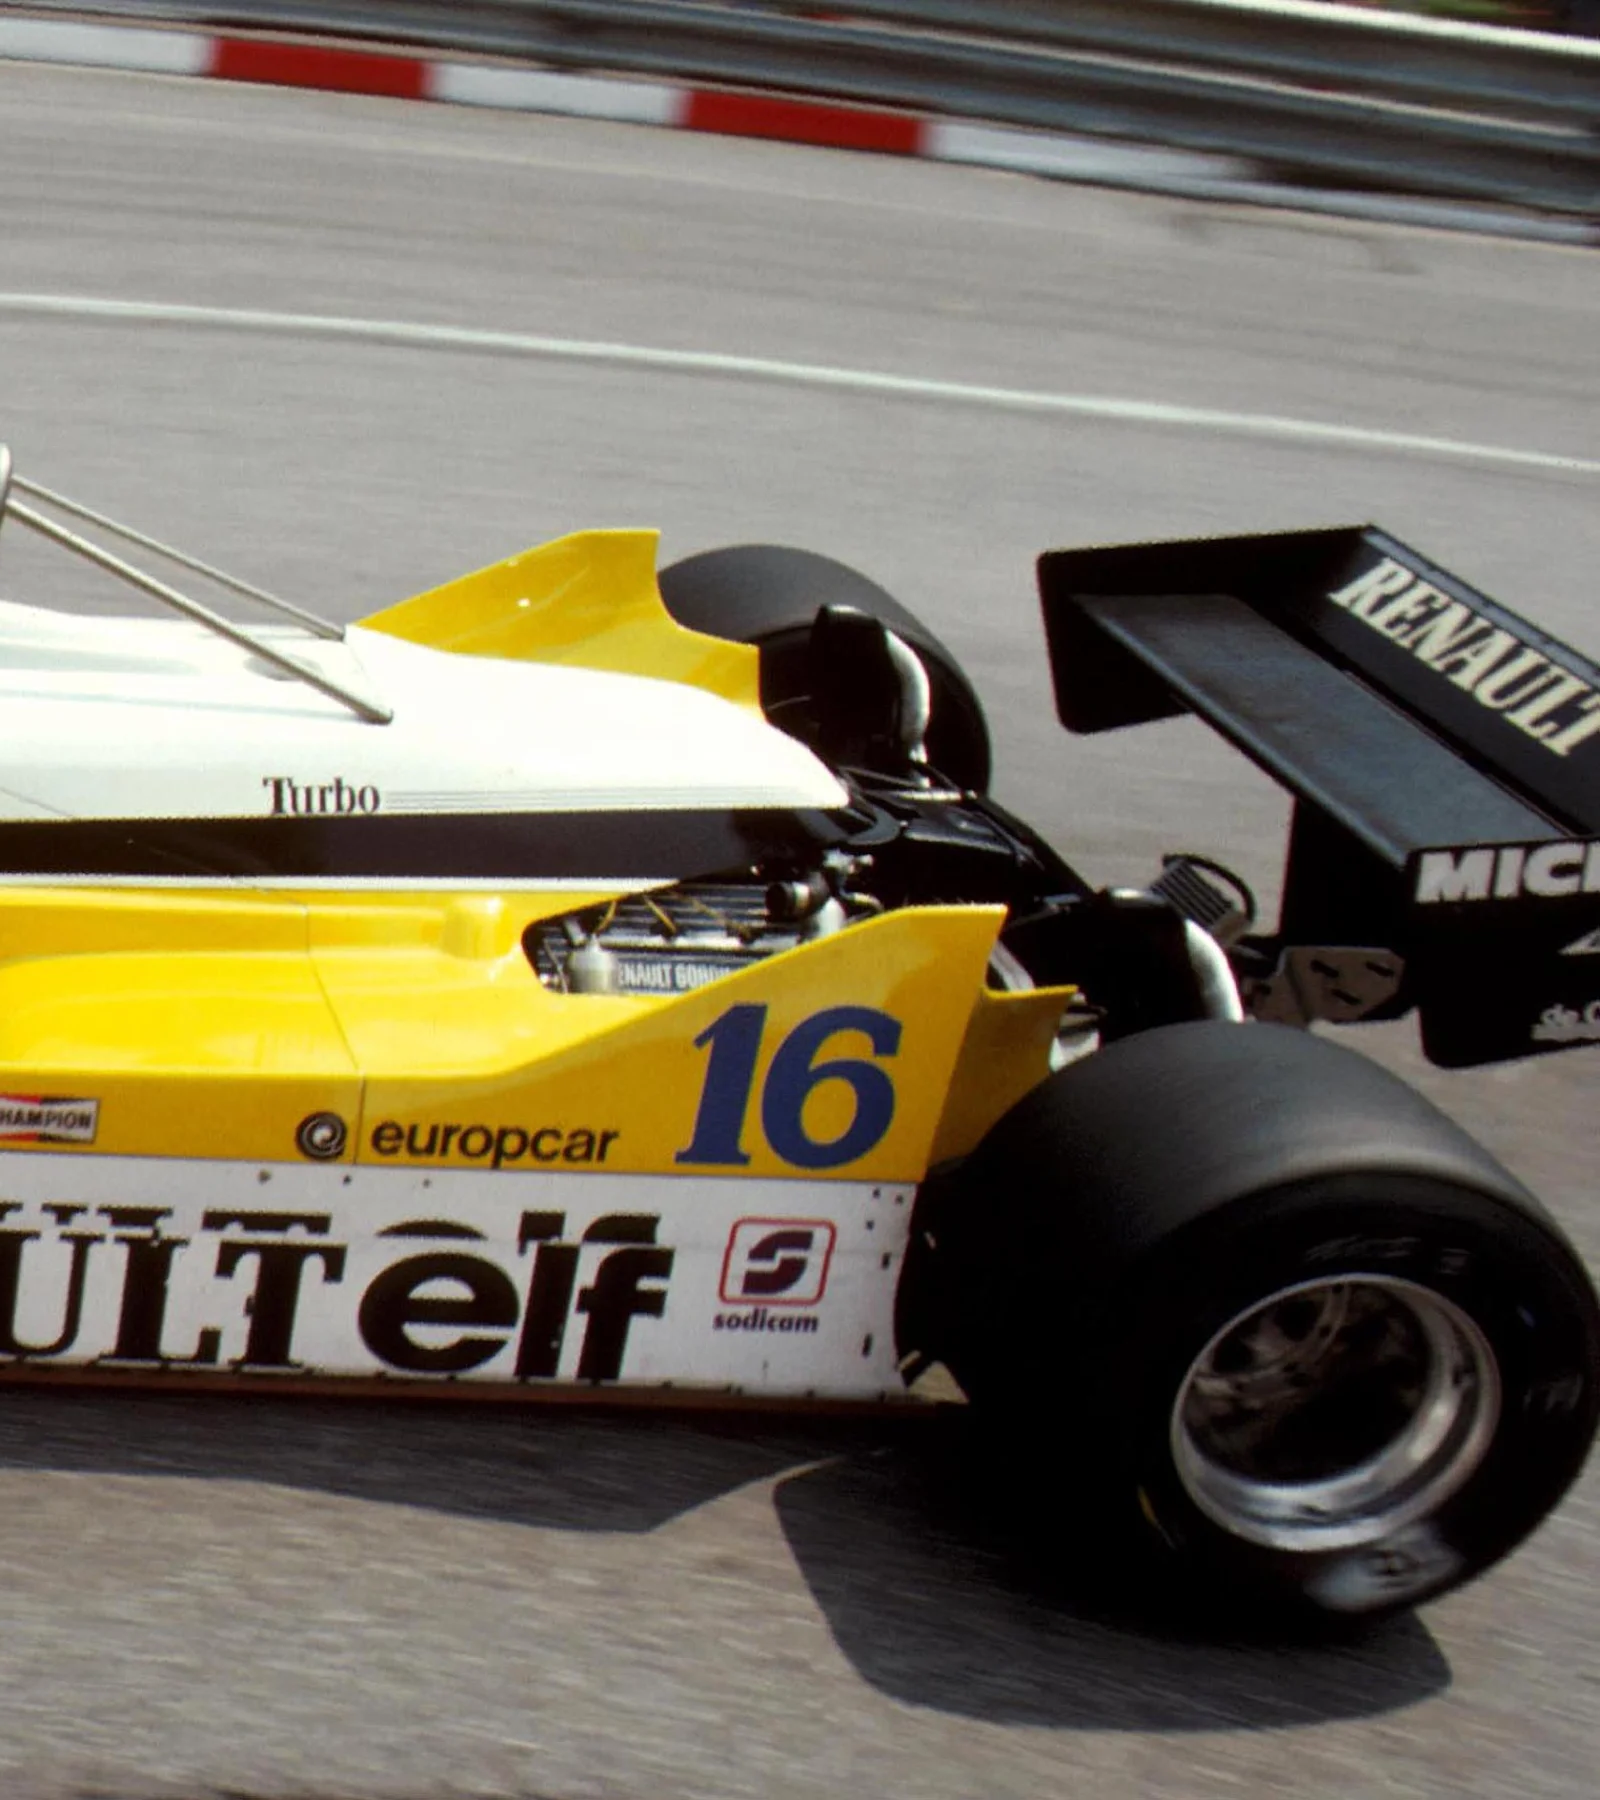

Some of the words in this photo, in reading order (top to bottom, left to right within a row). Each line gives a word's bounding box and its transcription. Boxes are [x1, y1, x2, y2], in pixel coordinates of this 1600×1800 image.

[1327, 556, 1600, 757] RENAULT
[262, 777, 380, 814] Turbo
[674, 1001, 902, 1169] 16
[371, 1120, 620, 1170] europcar
[358, 1210, 675, 1380] elf
[712, 1307, 819, 1333] sodicam
